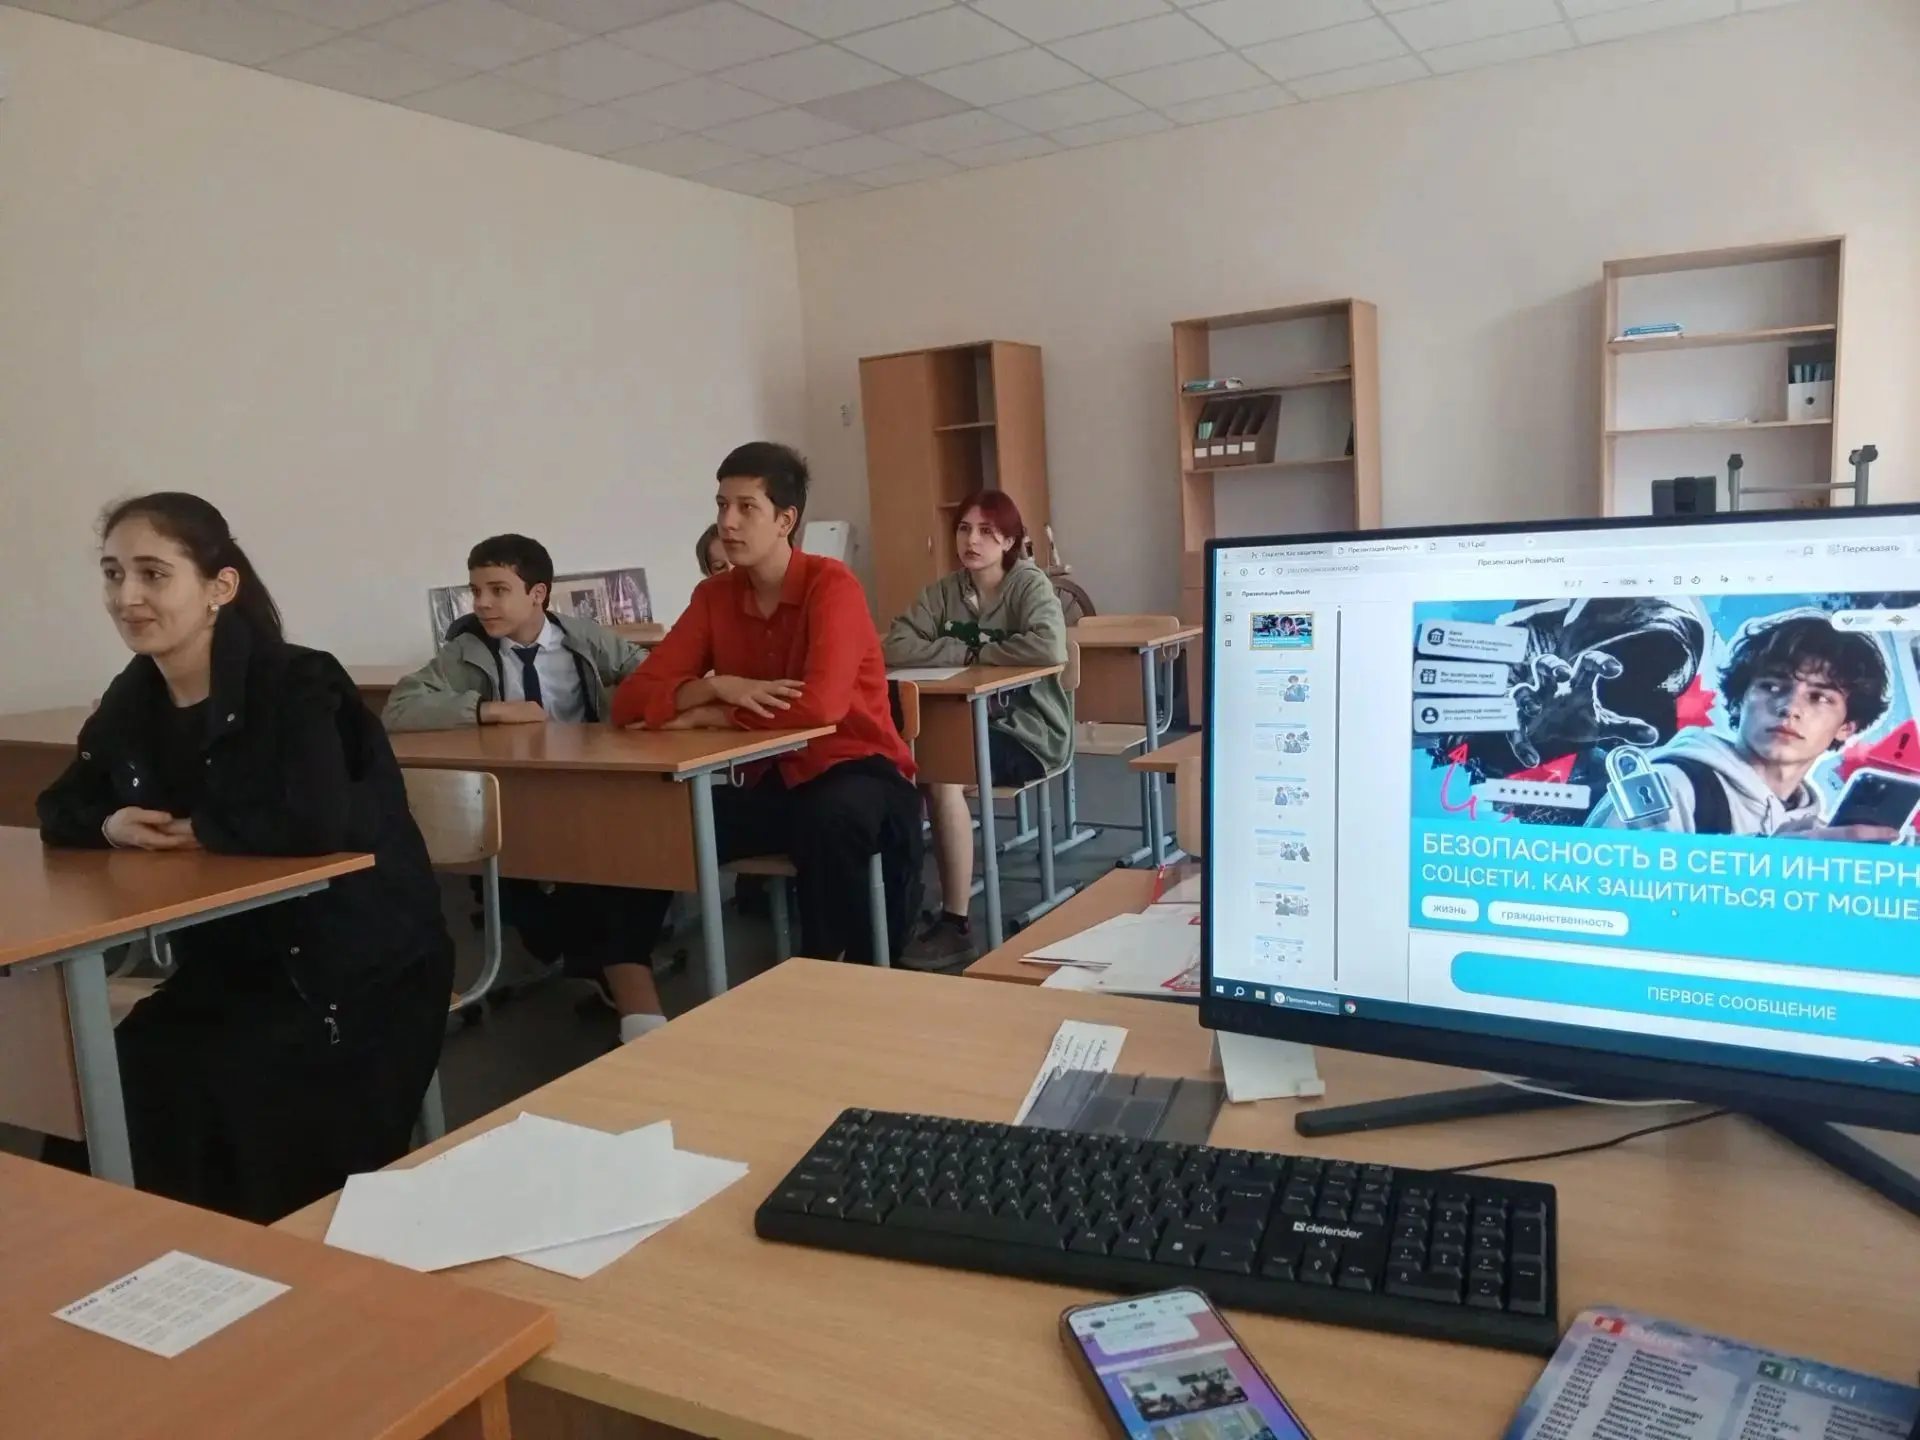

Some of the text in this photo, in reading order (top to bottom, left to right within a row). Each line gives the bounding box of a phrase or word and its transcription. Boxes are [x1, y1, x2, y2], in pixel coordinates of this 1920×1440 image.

[1842, 544, 1900, 554] Пересказать
[1477, 556, 1565, 567] Презентация PowerPoint
[1279, 588, 1311, 596] PowerPoint
[1422, 832, 1920, 887] БЕЗОПАСНОСТЬ В СЕТИ ИНТЕРН
[1421, 864, 1920, 920] СОЦСЕТИ. КАК ЗАЩИТИТЬСЯ ОТ МОШЕ
[1433, 903, 1467, 915] жизнь
[1501, 909, 1615, 929] гражданственность
[1647, 986, 1837, 1020] ПЕРВОЕ СООБЩЕНИЕ
[1305, 1223, 1363, 1239] defender
[1803, 1373, 1857, 1399] Excel
